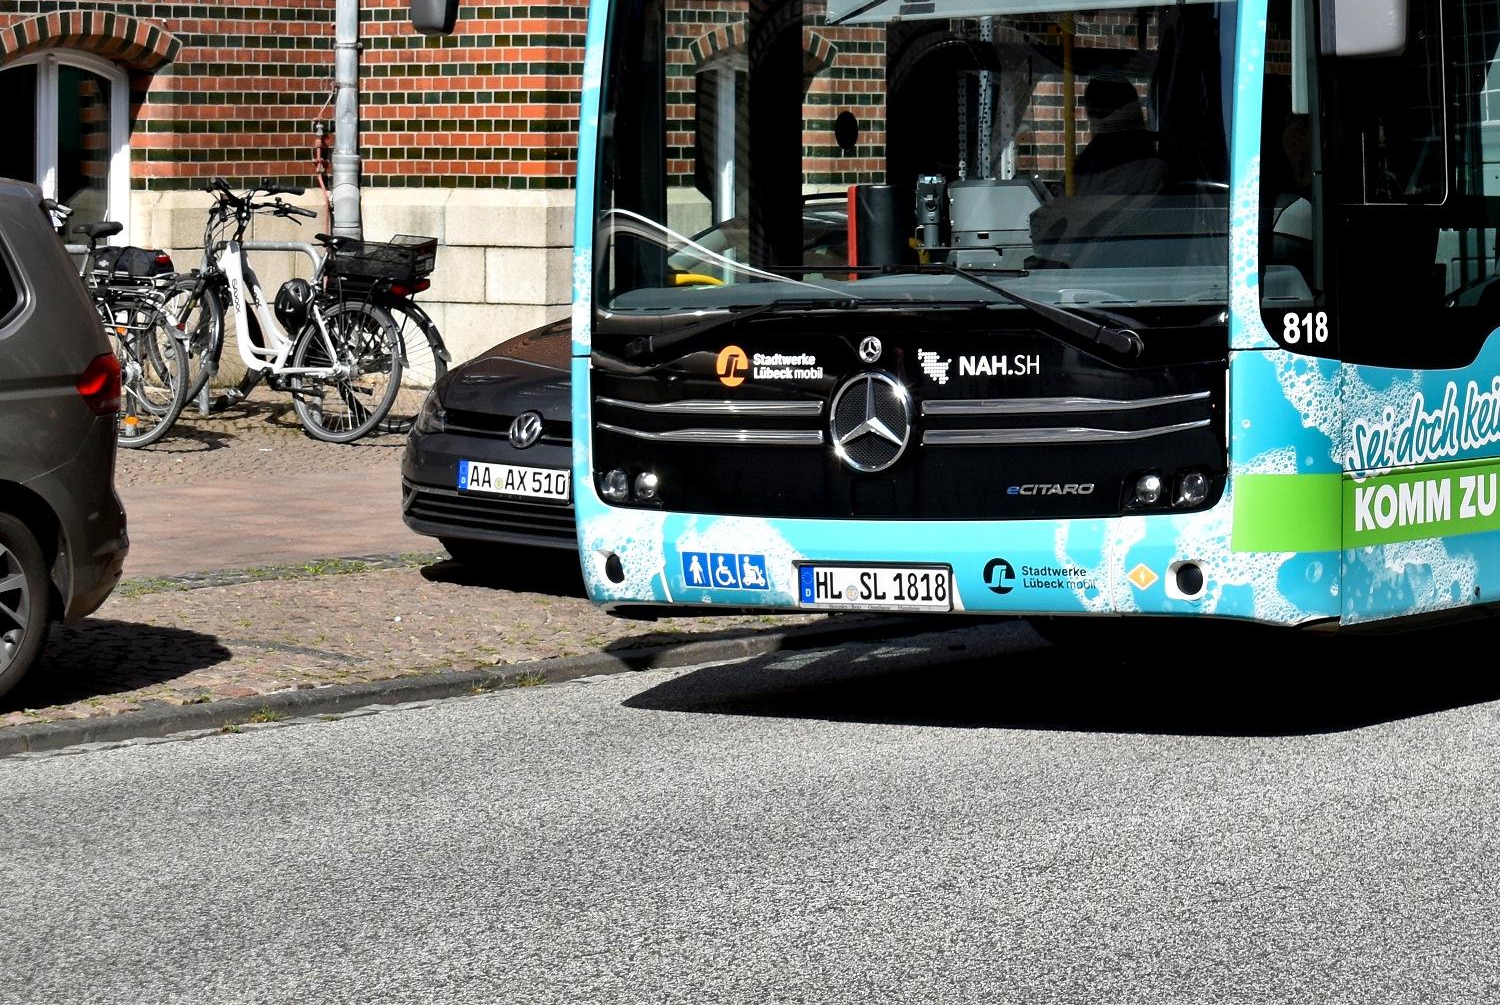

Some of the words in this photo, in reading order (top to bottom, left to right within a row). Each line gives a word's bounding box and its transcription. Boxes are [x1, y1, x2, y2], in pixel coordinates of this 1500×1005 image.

[1282, 311, 1329, 344] 818
[753, 353, 816, 366] Stadtwerke
[958, 354, 1040, 377] NAH.SH
[753, 366, 793, 380] Lübeck
[794, 366, 823, 380] mobil
[1348, 408, 1394, 480] Sei
[1395, 381, 1459, 465] doch
[470, 465, 492, 488] AA
[504, 469, 527, 492] AX
[532, 472, 567, 495] 510
[1006, 483, 1095, 495] eCITARO
[1355, 478, 1451, 532] KOMM
[1459, 473, 1497, 519] ZU
[1021, 566, 1087, 577] Stadtwerke
[816, 571, 842, 599] HL
[860, 572, 886, 600] SL
[893, 573, 946, 601] 1818
[1023, 578, 1064, 589] Lübeck
[1066, 579, 1096, 590] mobil
